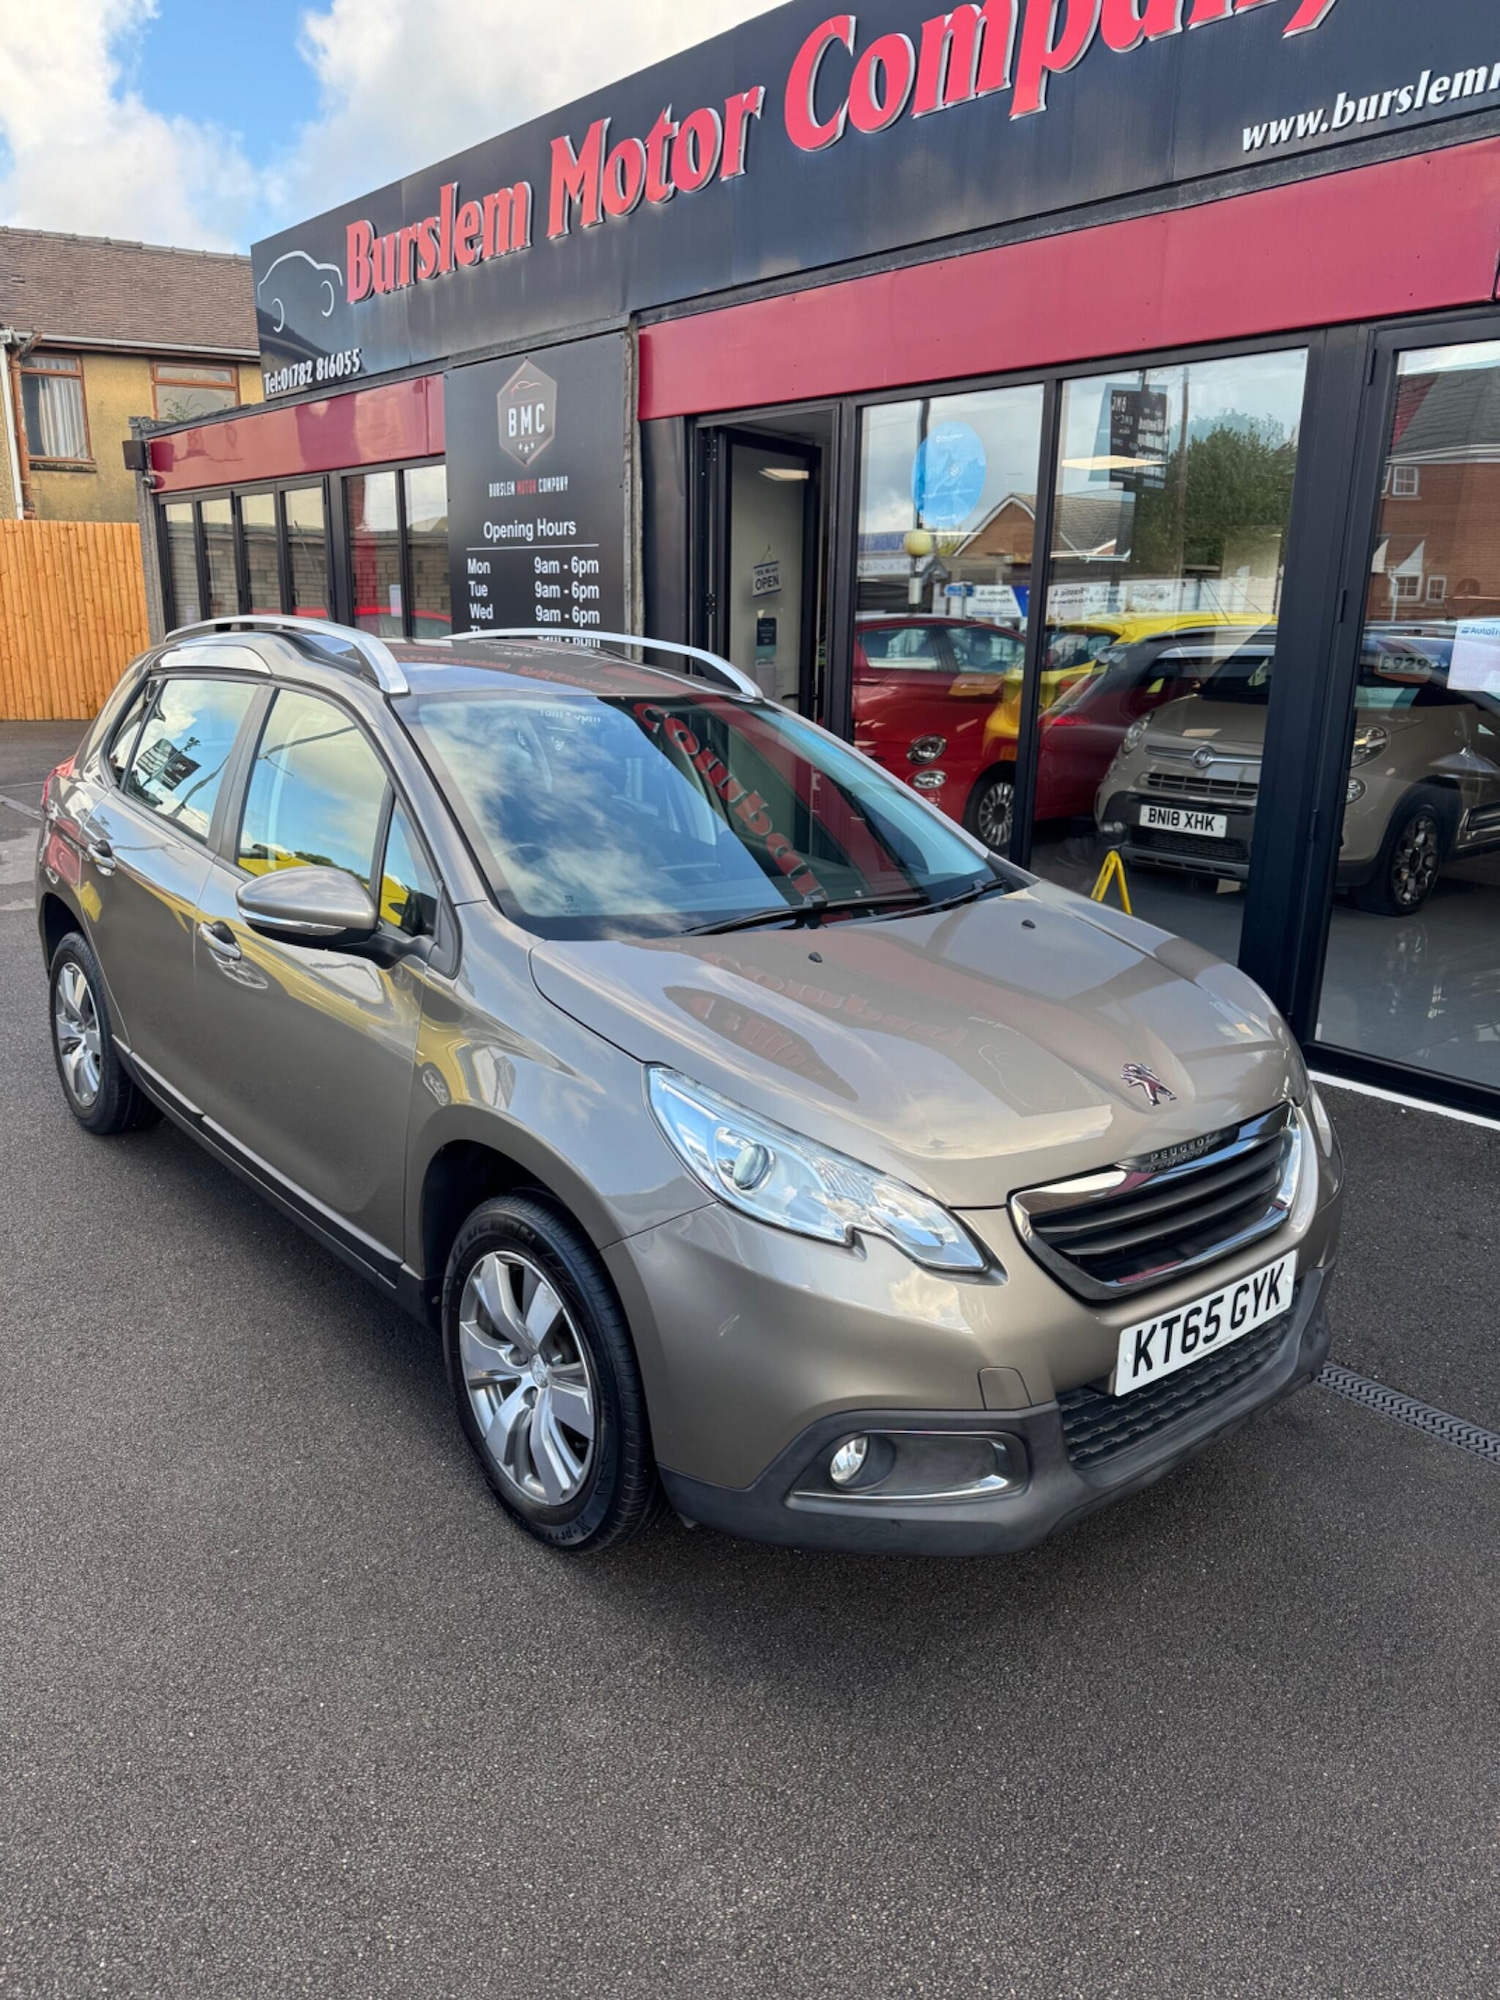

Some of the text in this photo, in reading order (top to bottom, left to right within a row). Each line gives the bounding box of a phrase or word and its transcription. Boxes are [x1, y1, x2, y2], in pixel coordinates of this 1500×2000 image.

[346, 181, 533, 304] Burslem
[547, 85, 766, 241] Motor
[316, 348, 361, 381] 816055
[508, 402, 546, 438] BMC
[483, 518, 577, 543] Opening Hours
[467, 558, 491, 574] Mon
[534, 556, 560, 574] 9am
[571, 556, 599, 578] 6pm
[468, 581, 489, 597] Tue
[534, 581, 561, 598] 9am
[571, 581, 599, 603] 6pm
[755, 575, 780, 591] OPEN
[469, 603, 494, 620] Wed
[535, 605, 561, 622] 9am
[572, 605, 600, 628] 6pm
[1470, 627, 1500, 636] AutoTr
[1147, 808, 1215, 832] BN18 XHK
[1150, 1134, 1212, 1162] PEUGEOT
[1132, 1262, 1286, 1378] KT65 GYK
